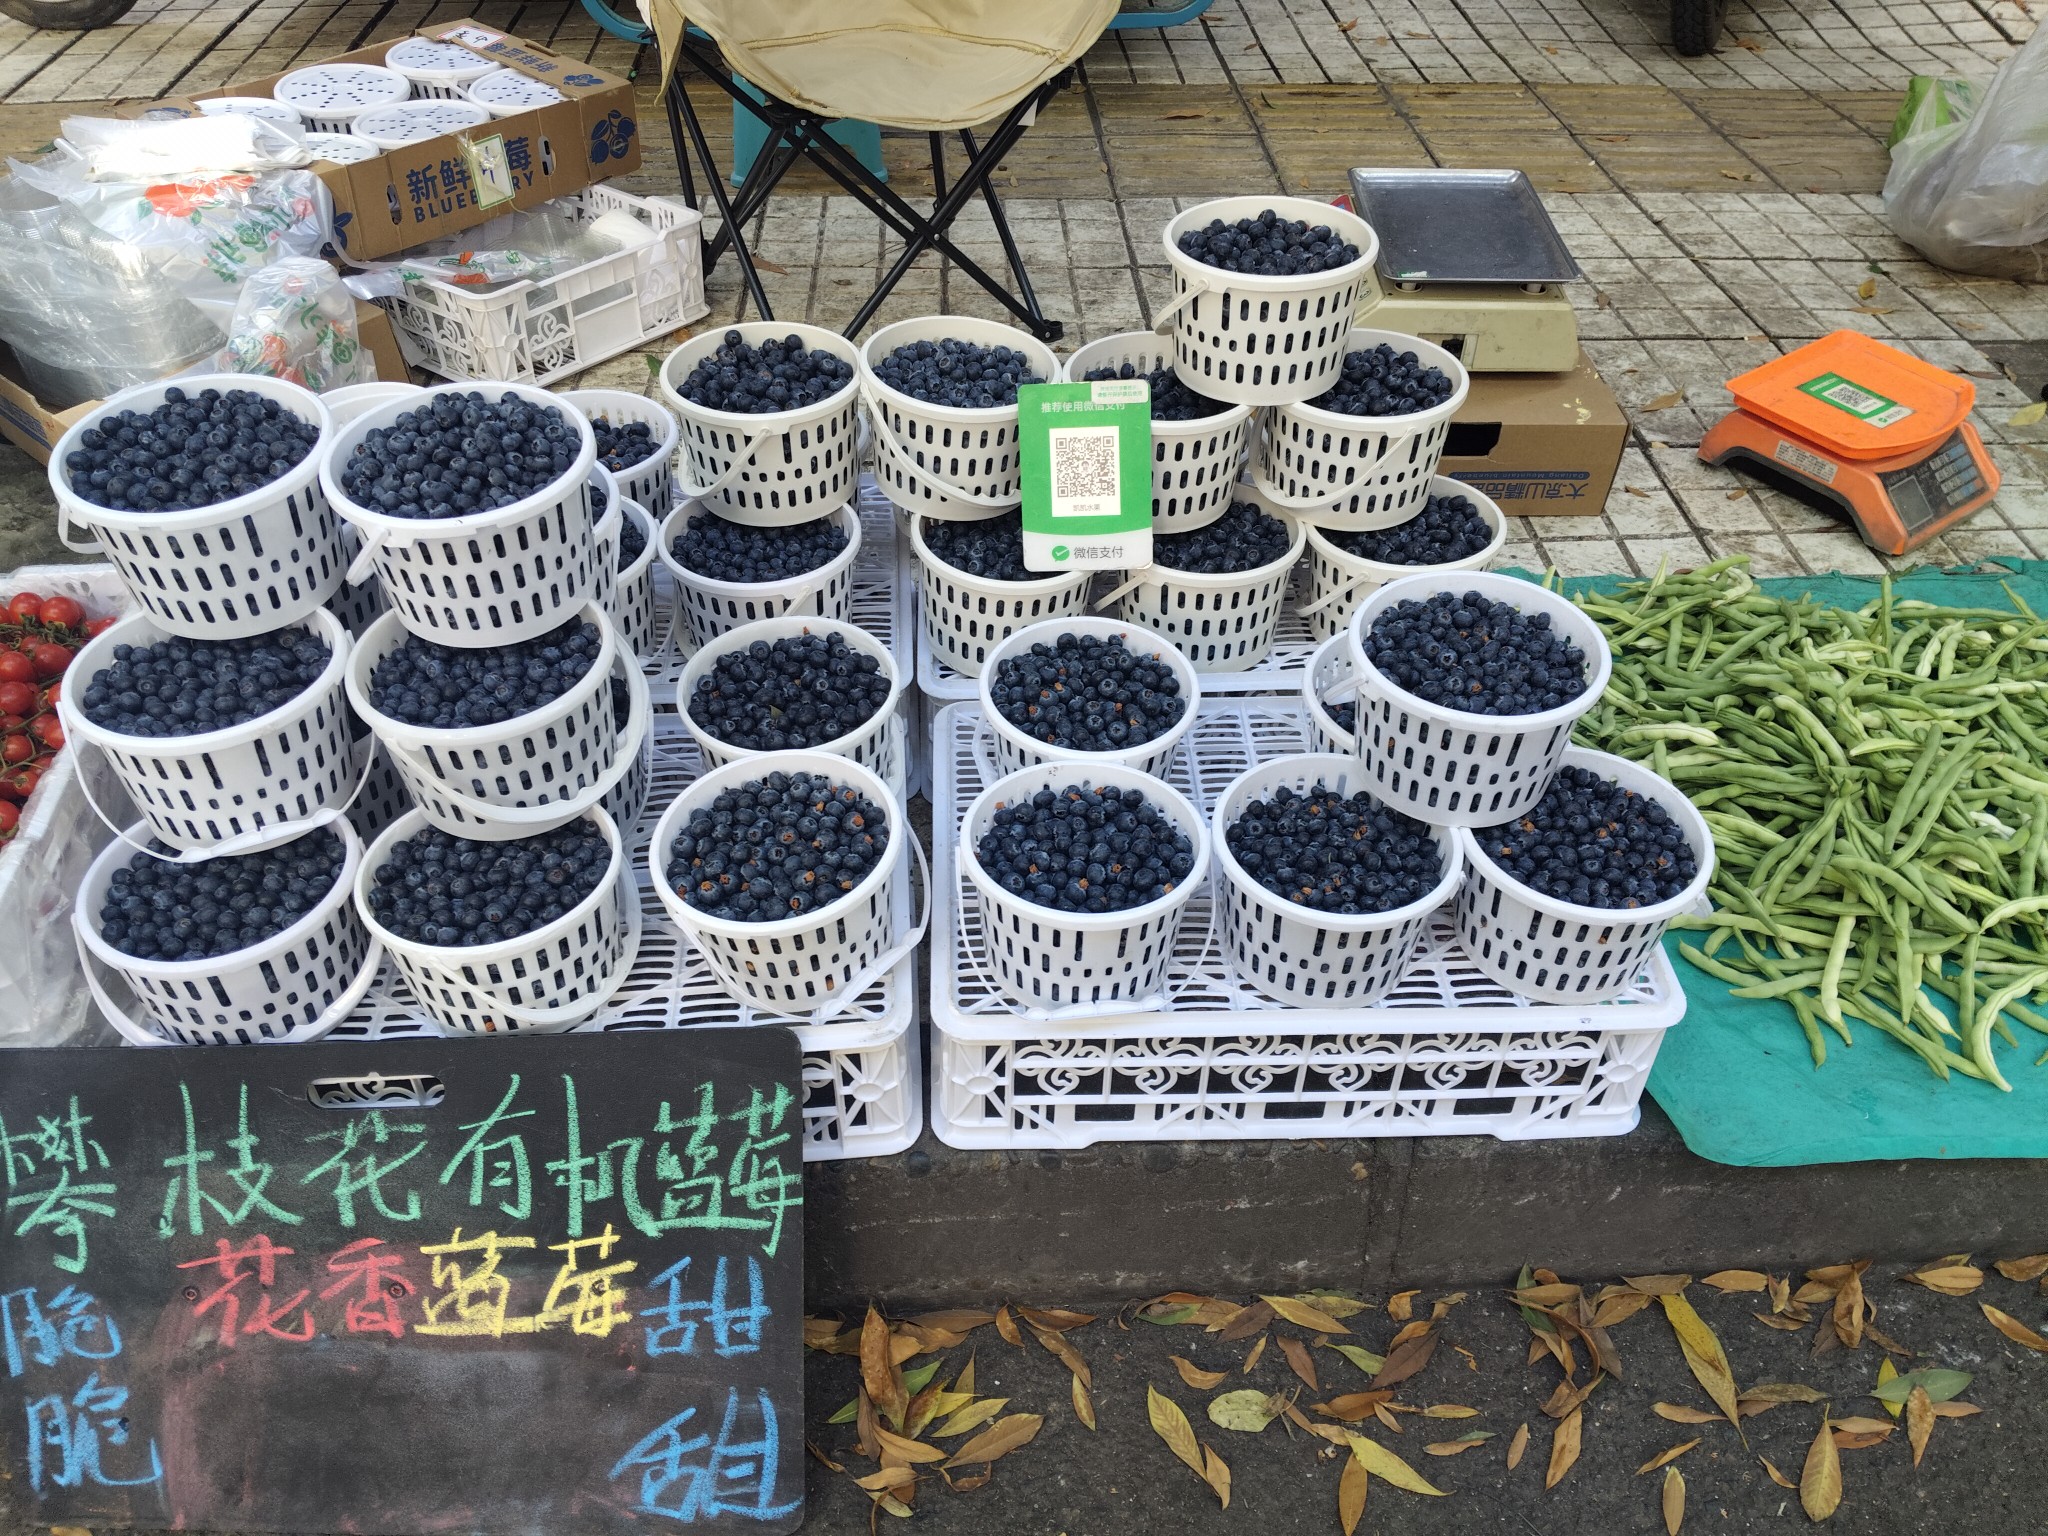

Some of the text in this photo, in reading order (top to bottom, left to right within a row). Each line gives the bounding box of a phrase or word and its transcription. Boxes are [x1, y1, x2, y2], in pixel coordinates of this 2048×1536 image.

[406, 136, 531, 204] 新鲜莓
[413, 170, 534, 223] BLUEBRY
[1073, 545, 1124, 560] 微信支付
[176, 1223, 638, 1345] 花香蓝莓
